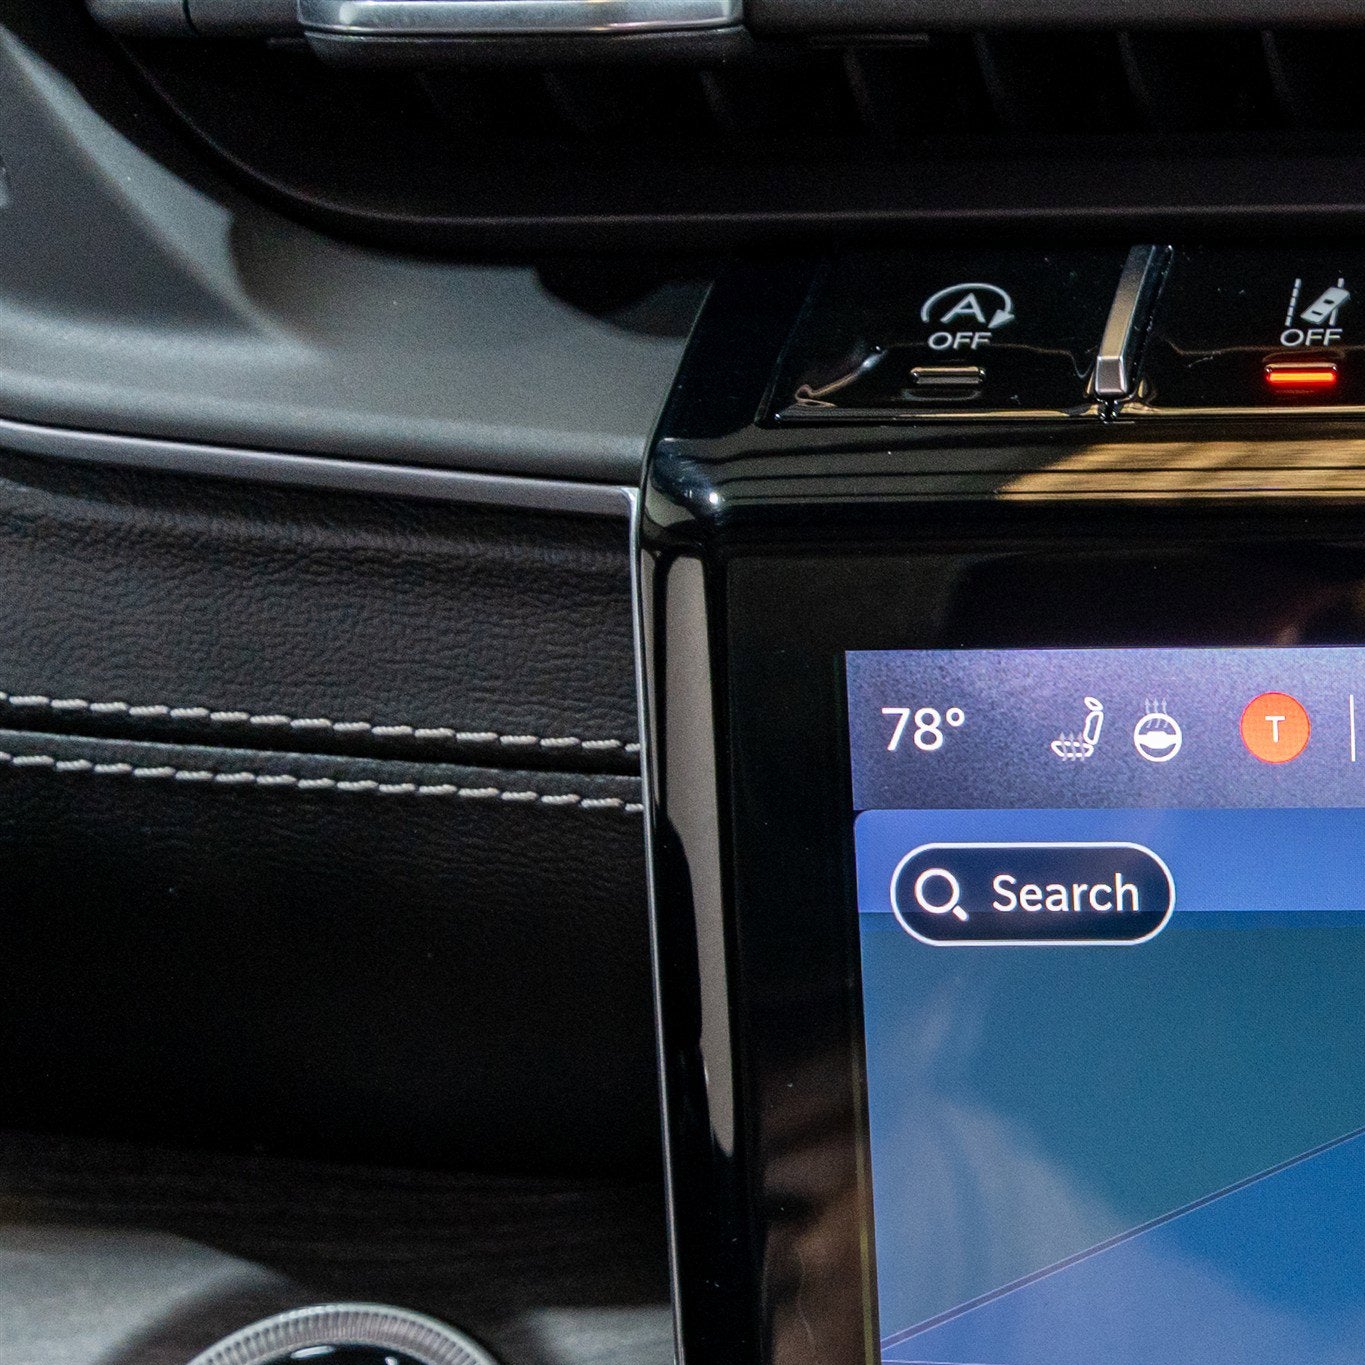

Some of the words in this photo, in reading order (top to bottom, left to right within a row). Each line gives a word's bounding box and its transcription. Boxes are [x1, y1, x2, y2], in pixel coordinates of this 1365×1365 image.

[927, 331, 992, 350] OFF
[1279, 328, 1343, 347] OFF
[992, 872, 1139, 912] Search
